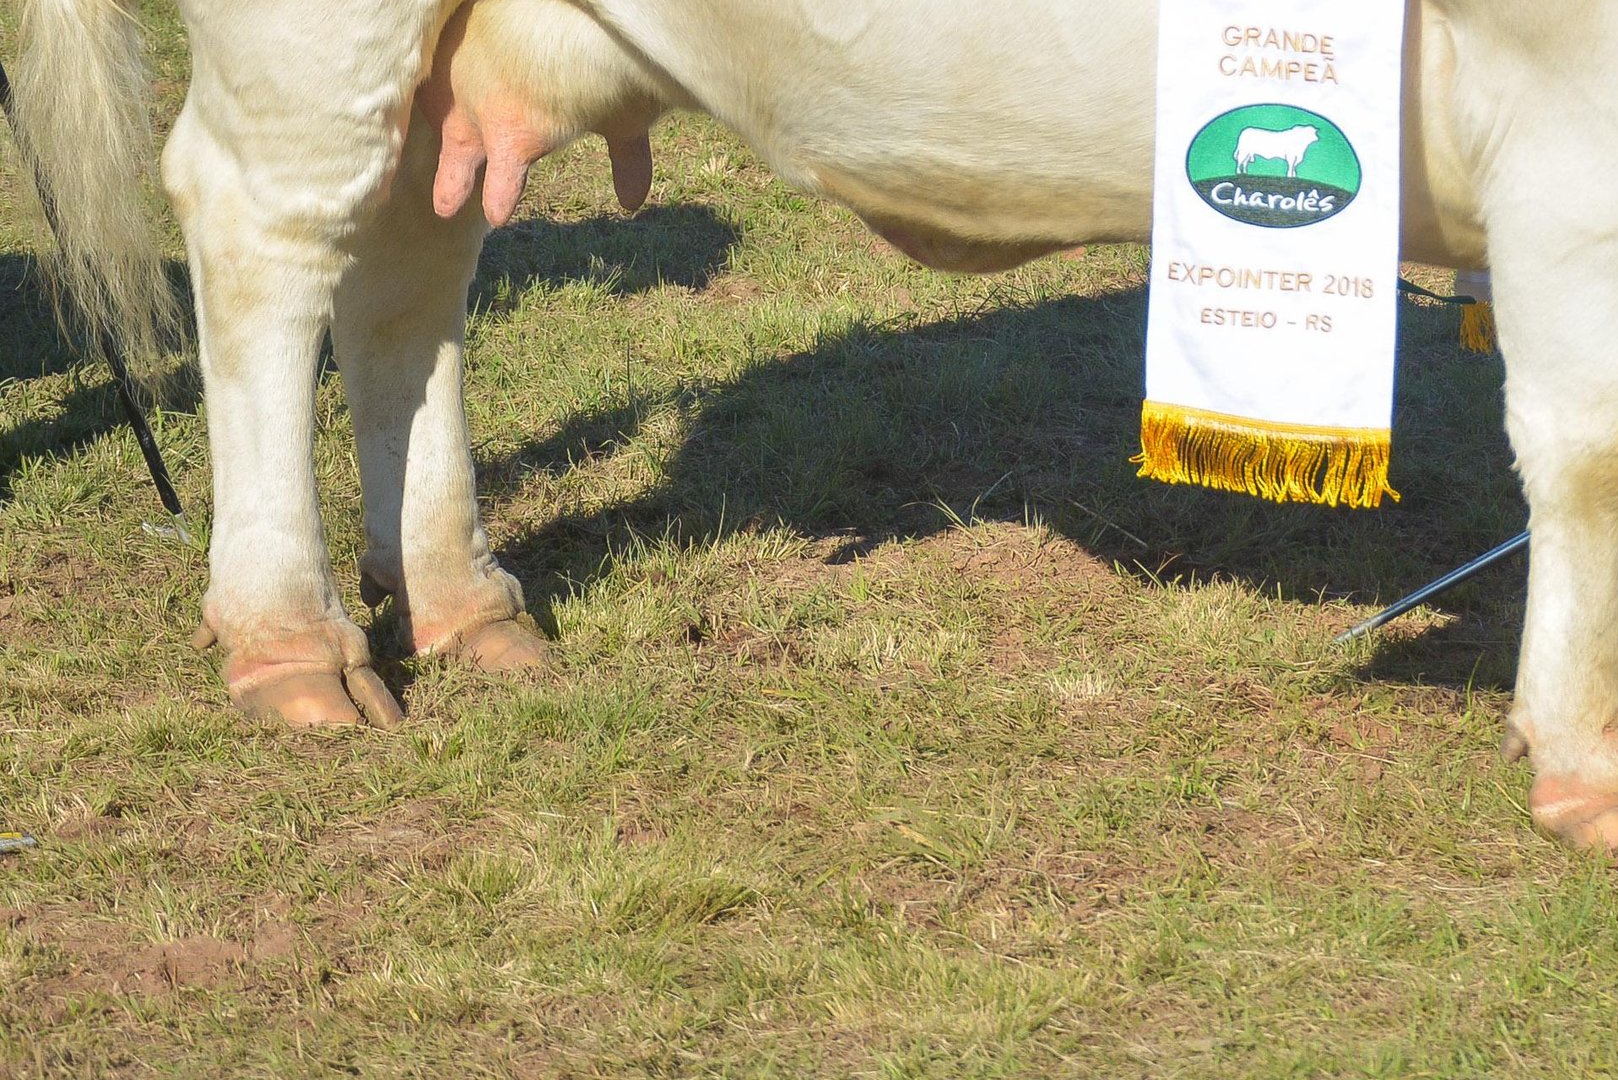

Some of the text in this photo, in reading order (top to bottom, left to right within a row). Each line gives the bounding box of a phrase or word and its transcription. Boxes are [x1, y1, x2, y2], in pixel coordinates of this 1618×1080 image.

[1222, 25, 1335, 56] GRANDE
[1218, 55, 1340, 85] CAMPEÃ
[1210, 181, 1336, 213] Charolês
[1167, 261, 1375, 299] EXPOINTER 2018
[1200, 307, 1277, 329] ESTEIO
[1305, 313, 1333, 333] RS
